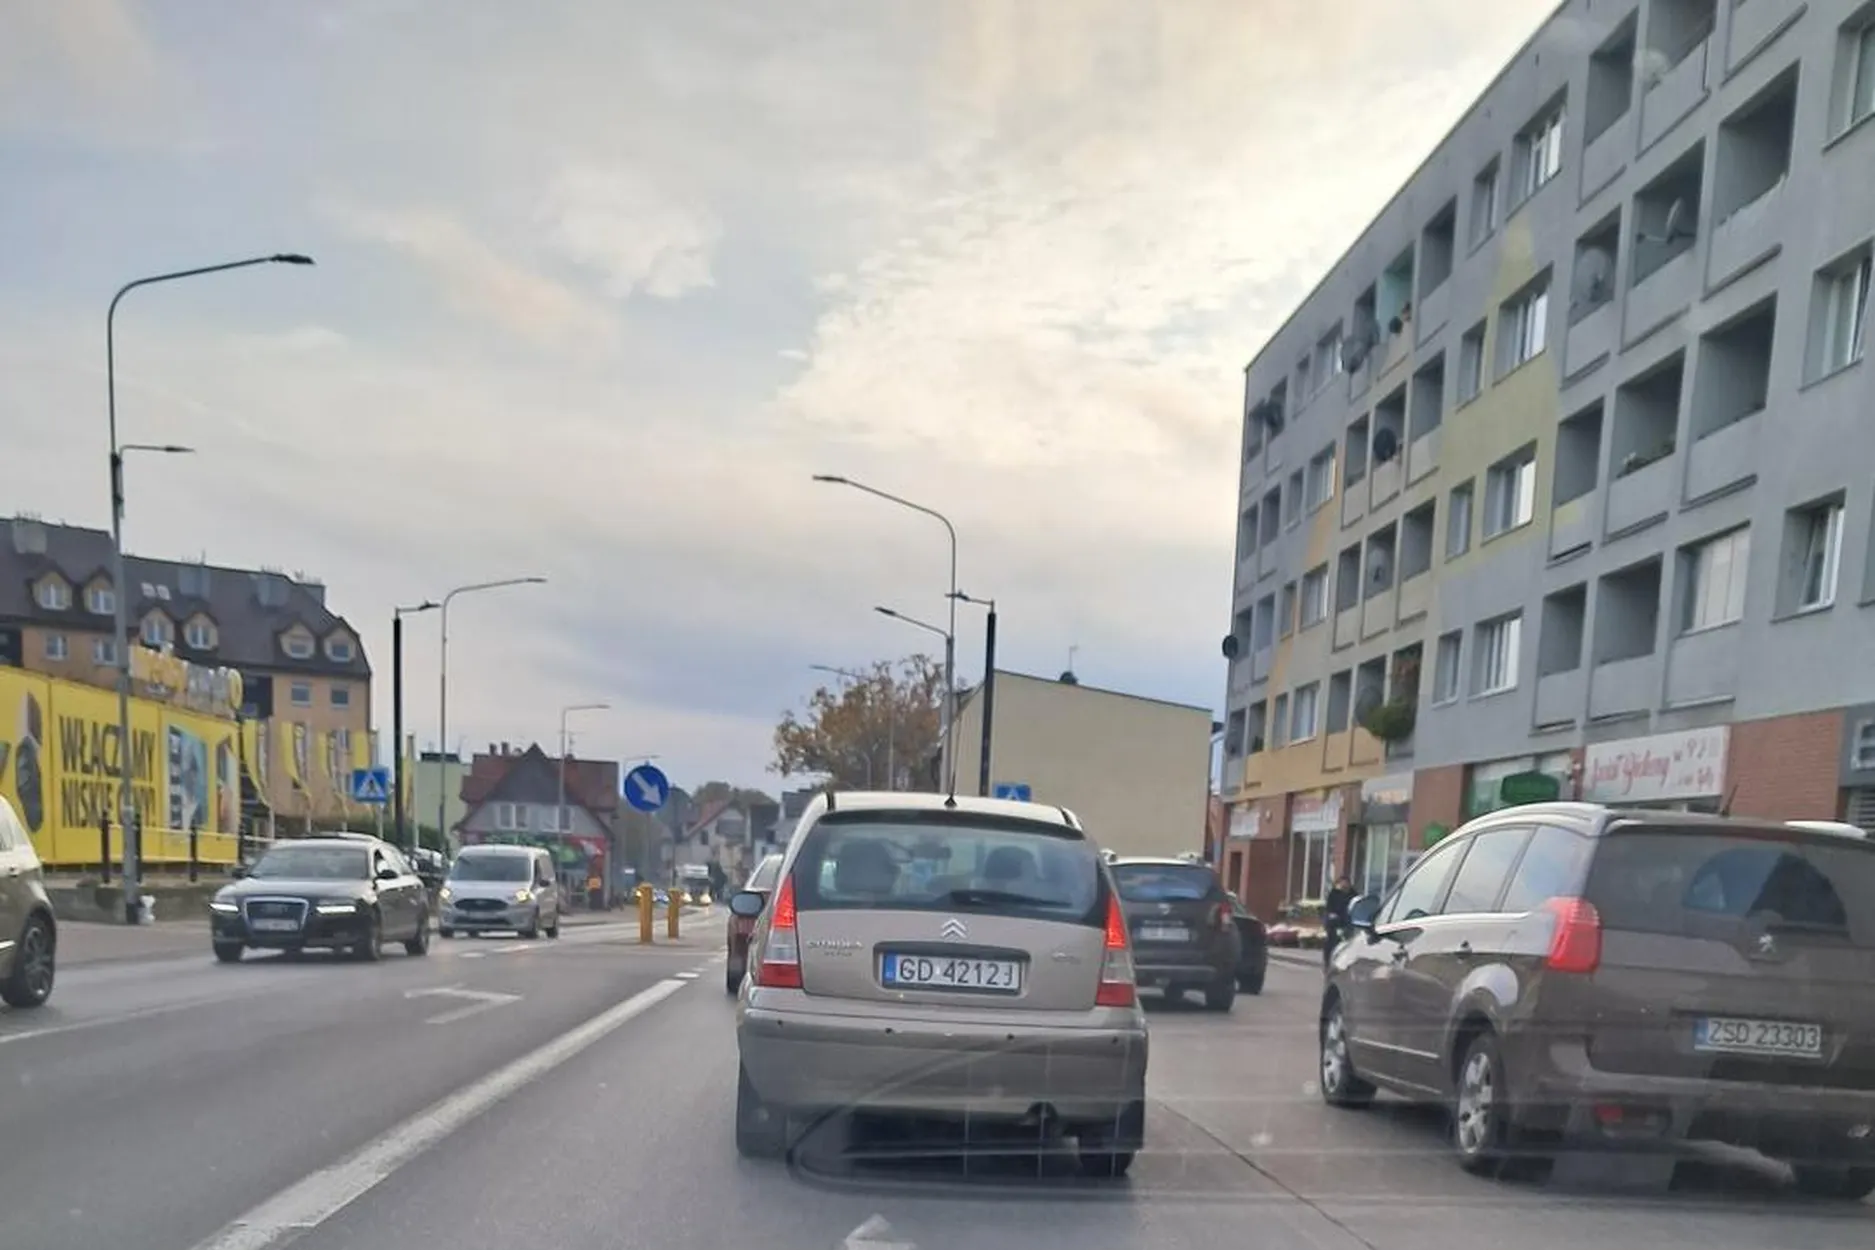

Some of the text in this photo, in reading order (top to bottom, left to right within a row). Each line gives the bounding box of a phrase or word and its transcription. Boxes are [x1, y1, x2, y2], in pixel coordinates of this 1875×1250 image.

[59, 714, 155, 782] WŁĄCZMY
[62, 777, 113, 828] NISKIE
[900, 958, 933, 981] GD
[1709, 1020, 1818, 1049] ZSD 23303
